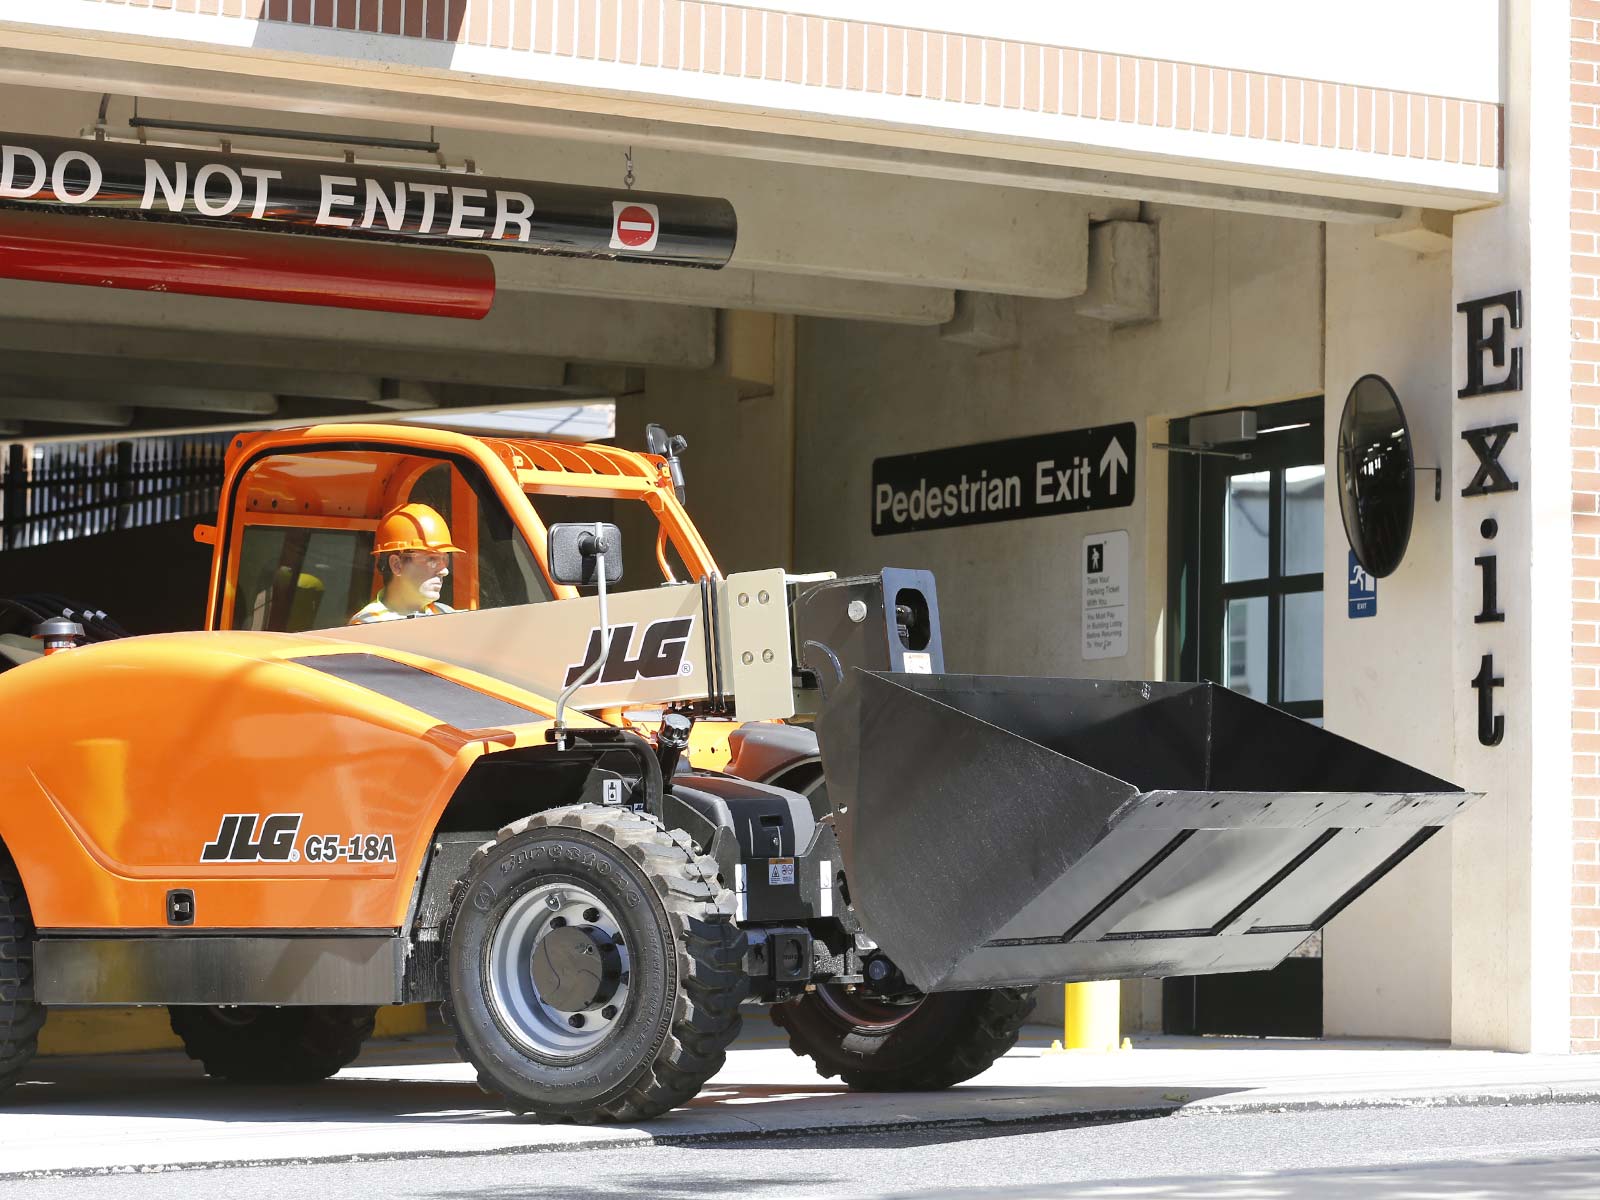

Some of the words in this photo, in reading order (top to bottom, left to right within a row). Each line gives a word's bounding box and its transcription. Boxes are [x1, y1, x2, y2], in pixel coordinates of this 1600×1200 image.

[0, 144, 102, 204] DO
[141, 157, 282, 220] NOT
[315, 173, 536, 242] ENTER
[875, 470, 1021, 525] Pedestrian
[1035, 456, 1092, 504] Exit
[1456, 289, 1523, 747] Exit
[1356, 602, 1367, 610] EXIT
[563, 616, 695, 689] JLG
[201, 814, 302, 862] JLG
[304, 834, 397, 862] G5-18A
